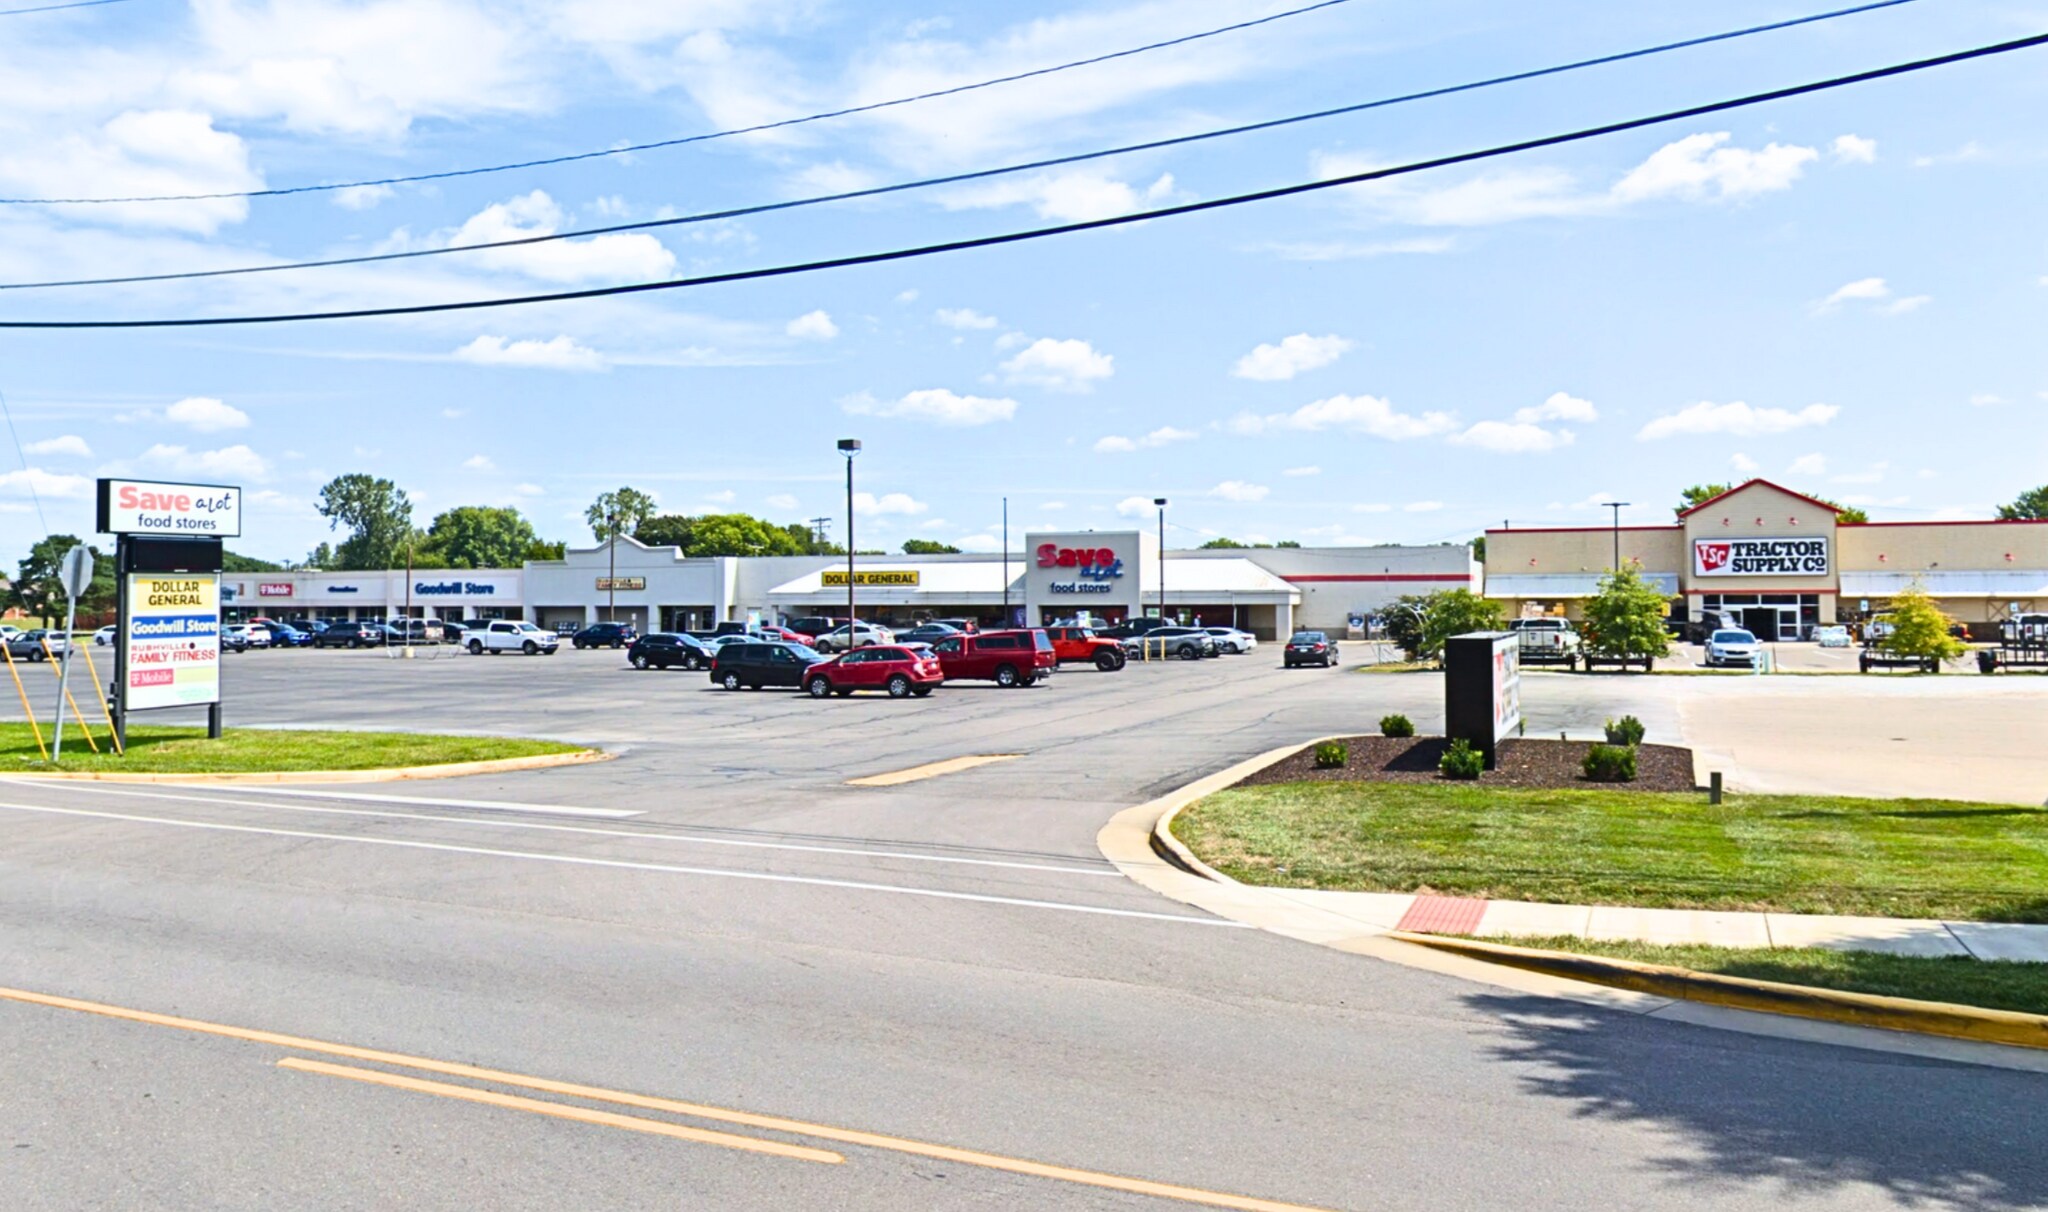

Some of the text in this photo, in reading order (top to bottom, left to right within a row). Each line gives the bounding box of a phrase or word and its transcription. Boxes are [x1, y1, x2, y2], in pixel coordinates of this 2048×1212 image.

[118, 486, 191, 512] Save
[138, 513, 217, 530] food stores
[1036, 543, 1114, 568] Save
[1700, 541, 1825, 566] TSC TRACTOR
[1731, 557, 1802, 573] SUPPLY
[825, 573, 915, 584] DOLLAR GENERAL
[151, 581, 200, 593] DOLLAR
[415, 582, 495, 595] Goodwill Store
[1050, 581, 1112, 593] food stores
[148, 594, 202, 606] GENERAL
[132, 618, 217, 635] Goodwill Store
[131, 649, 216, 664] FAMILY FITNESS
